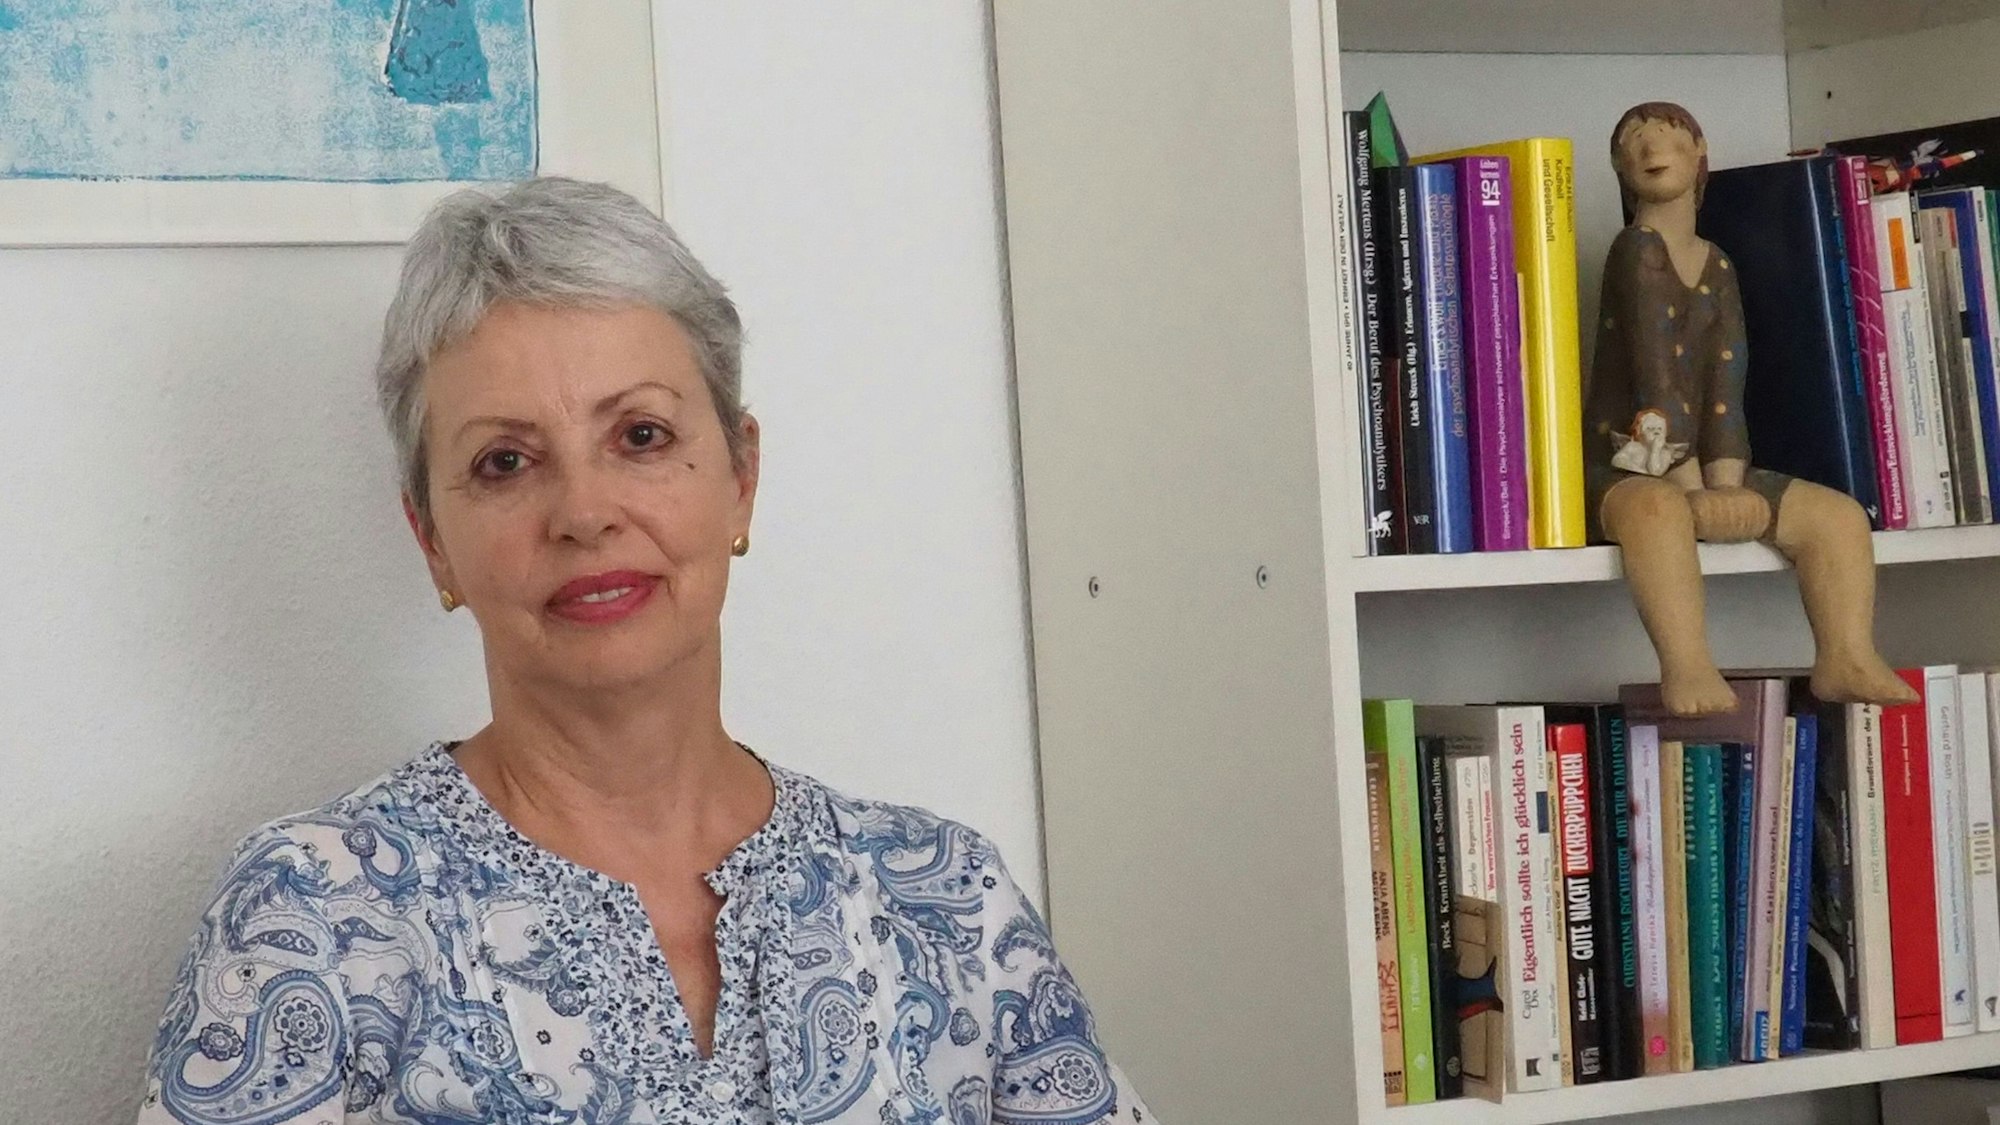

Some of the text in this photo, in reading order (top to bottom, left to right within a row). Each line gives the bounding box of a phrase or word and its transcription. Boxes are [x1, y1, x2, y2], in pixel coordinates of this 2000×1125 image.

[1481, 180, 1501, 200] 94
[1543, 158, 1556, 242] und Gesellschaft
[1555, 159, 1565, 199] Kindheit
[1400, 240, 1410, 258] und
[1402, 259, 1412, 291] Agieren
[1356, 129, 1387, 491] Wolfgang Mertens (Hrsg.) Der Beruf des Psychoanalytikers
[1439, 193, 1465, 437] der psychoanalytischen Selbstpsychologie
[1410, 400, 1421, 426] Ulrich
[1496, 386, 1508, 456] Psychoanalyse
[1610, 718, 1627, 785] DAHINTEN
[1863, 718, 1872, 732] der
[1940, 706, 1952, 751] Gerhard
[1865, 736, 1876, 799] Grundformen
[1942, 754, 1953, 780] Roth
[1431, 757, 1451, 949] Beck Krankheit als Selbstheilung
[1466, 798, 1477, 855] Depression
[1510, 723, 1538, 982] Eigentlich sollte ich glücklich sein
[1560, 753, 1594, 960] GUTE NACHT ZUCKERPÜPPCHEN
[1379, 871, 1391, 936] ANJA ABENS
[1620, 920, 1636, 988] CHRISTIANE
[1521, 989, 1532, 1020] Carol
[1530, 989, 1539, 1009] Dix
